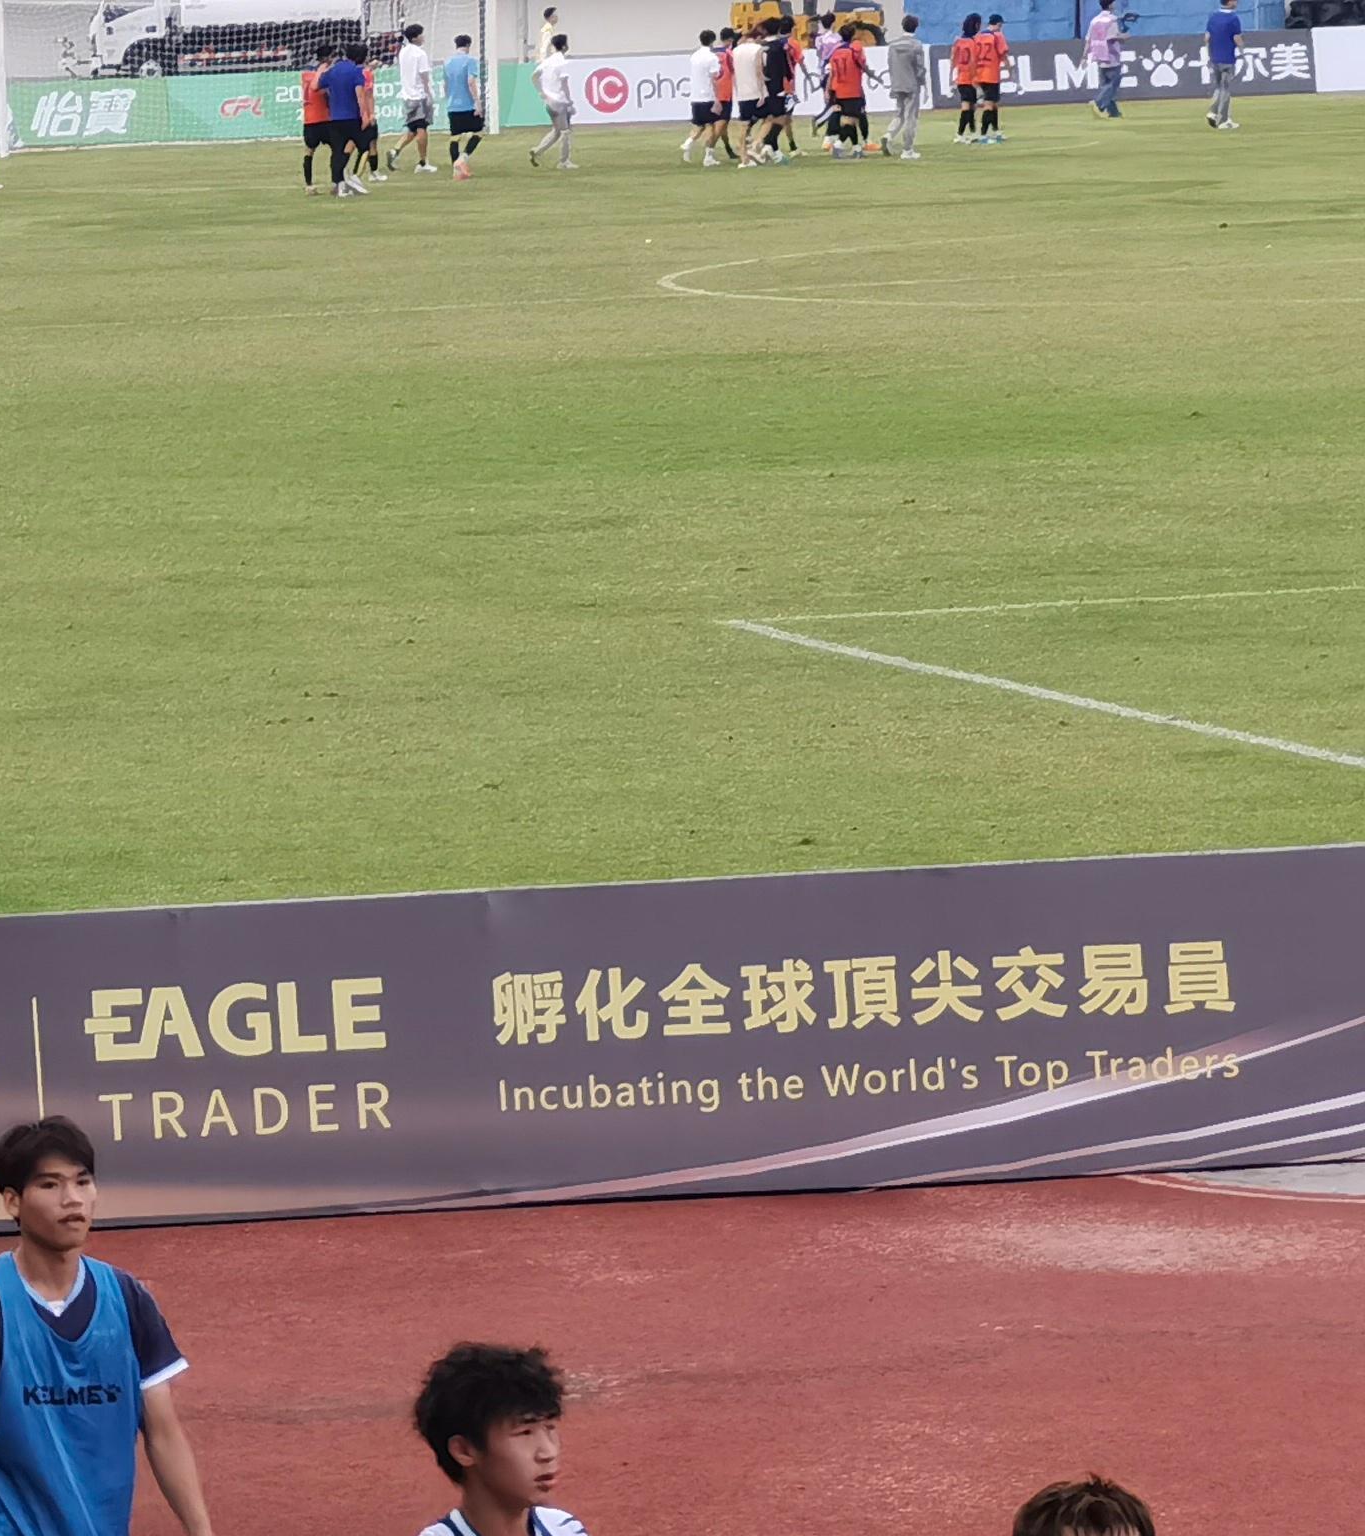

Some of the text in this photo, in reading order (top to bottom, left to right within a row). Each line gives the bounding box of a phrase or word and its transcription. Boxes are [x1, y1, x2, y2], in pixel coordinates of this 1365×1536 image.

[85, 977, 388, 1062] EAGLE
[493, 941, 1238, 1046] 孵化全球頂尖交易員
[98, 1081, 392, 1141] TRADER
[498, 1045, 1240, 1114] Incubating the World's Top Traders
